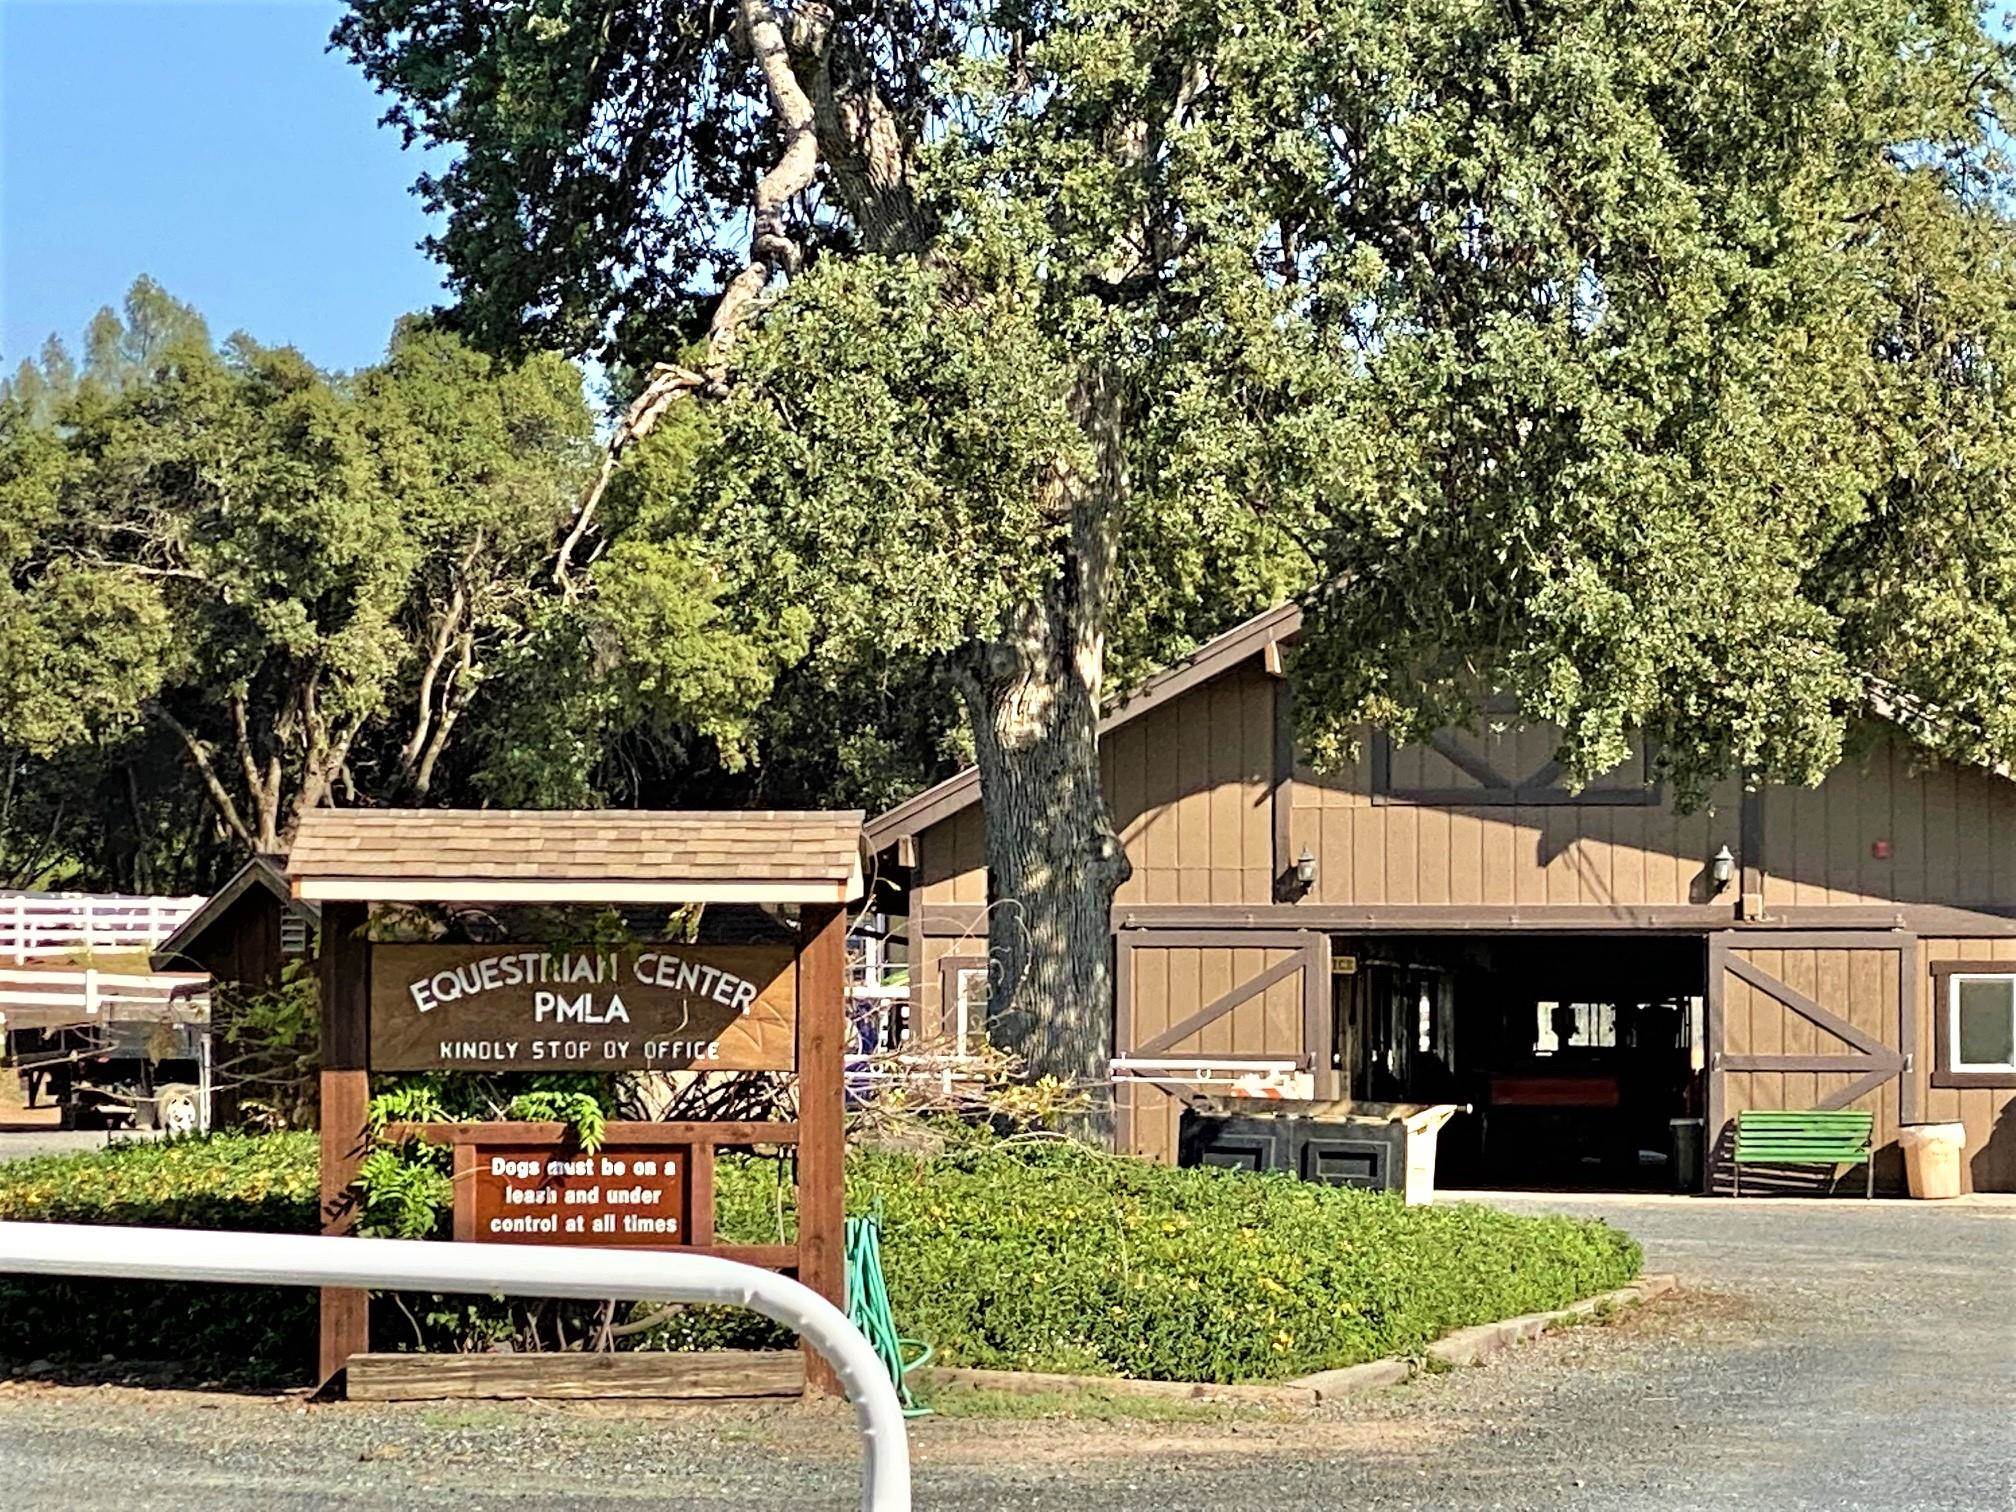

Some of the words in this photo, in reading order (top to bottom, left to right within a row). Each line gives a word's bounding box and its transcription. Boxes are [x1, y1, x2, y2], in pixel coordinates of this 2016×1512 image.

[409, 952, 618, 1013] EQUESTRIAN
[632, 953, 758, 1016] CENTER
[534, 990, 631, 1024] PMLA
[439, 1041, 519, 1060] KINDLY
[532, 1040, 592, 1060] STOP
[644, 1040, 720, 1060] OFFICE
[491, 1157, 540, 1178] Dogs
[546, 1158, 595, 1176] must
[601, 1157, 626, 1176] be
[633, 1160, 657, 1176] on
[664, 1160, 676, 1176] a
[505, 1184, 558, 1205] leash
[564, 1185, 600, 1205] and
[606, 1185, 662, 1205] under
[490, 1214, 558, 1233] control
[565, 1215, 585, 1233] at
[592, 1214, 616, 1233] all
[623, 1214, 678, 1233] times
